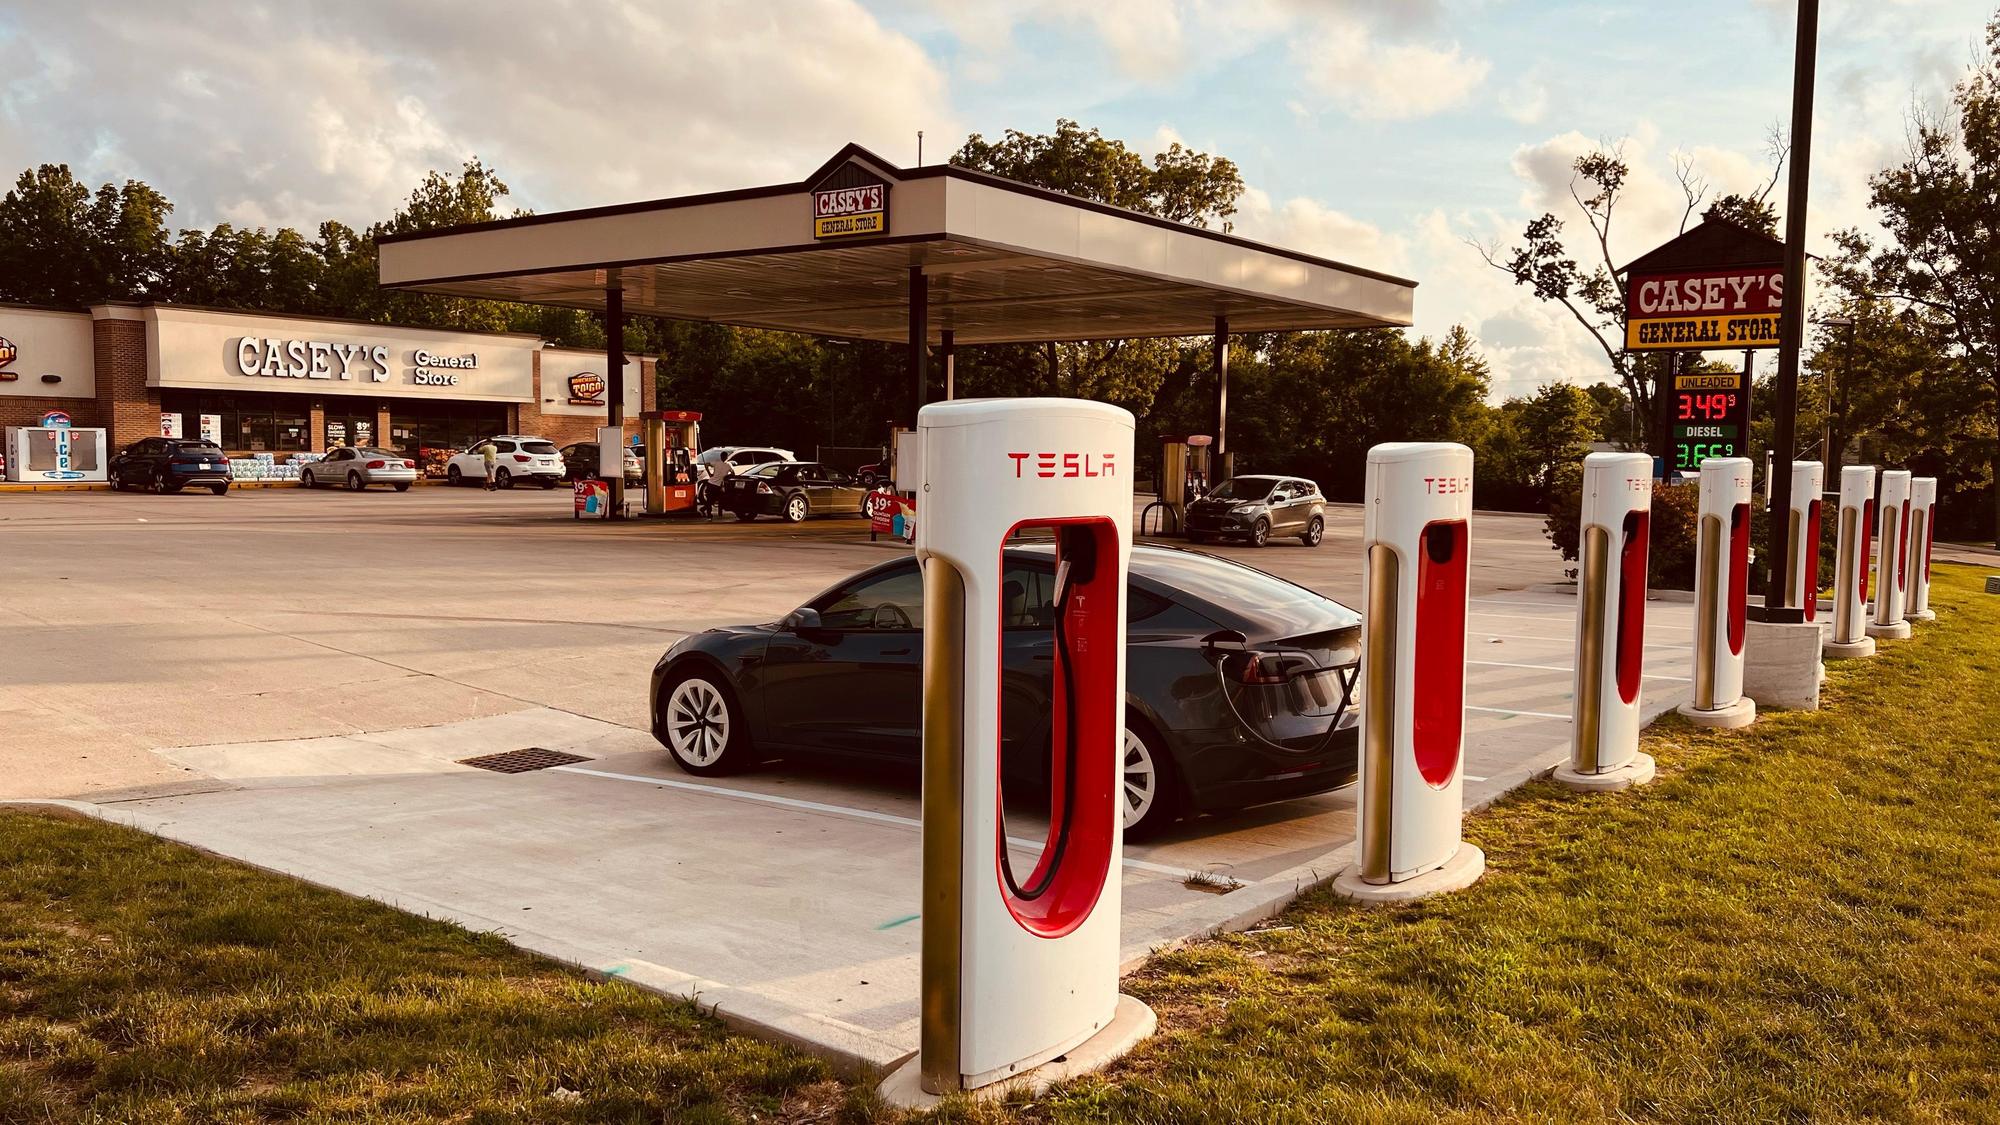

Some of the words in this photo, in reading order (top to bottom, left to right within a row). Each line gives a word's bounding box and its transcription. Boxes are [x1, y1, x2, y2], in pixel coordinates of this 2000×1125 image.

[820, 188, 879, 215] CASEY'S
[821, 218, 854, 234] GENERAL
[855, 216, 877, 231] STORE
[1639, 273, 1783, 313] CASEY'S
[1639, 320, 1720, 344] GENERAL
[238, 336, 391, 383] CASEY'S
[415, 349, 480, 369] General
[415, 366, 460, 386] Store
[1681, 377, 1735, 388] UNLEADED
[1686, 426, 1723, 437] DIESEL
[1007, 453, 1115, 478] TESLA
[1424, 477, 1469, 494] TESLA
